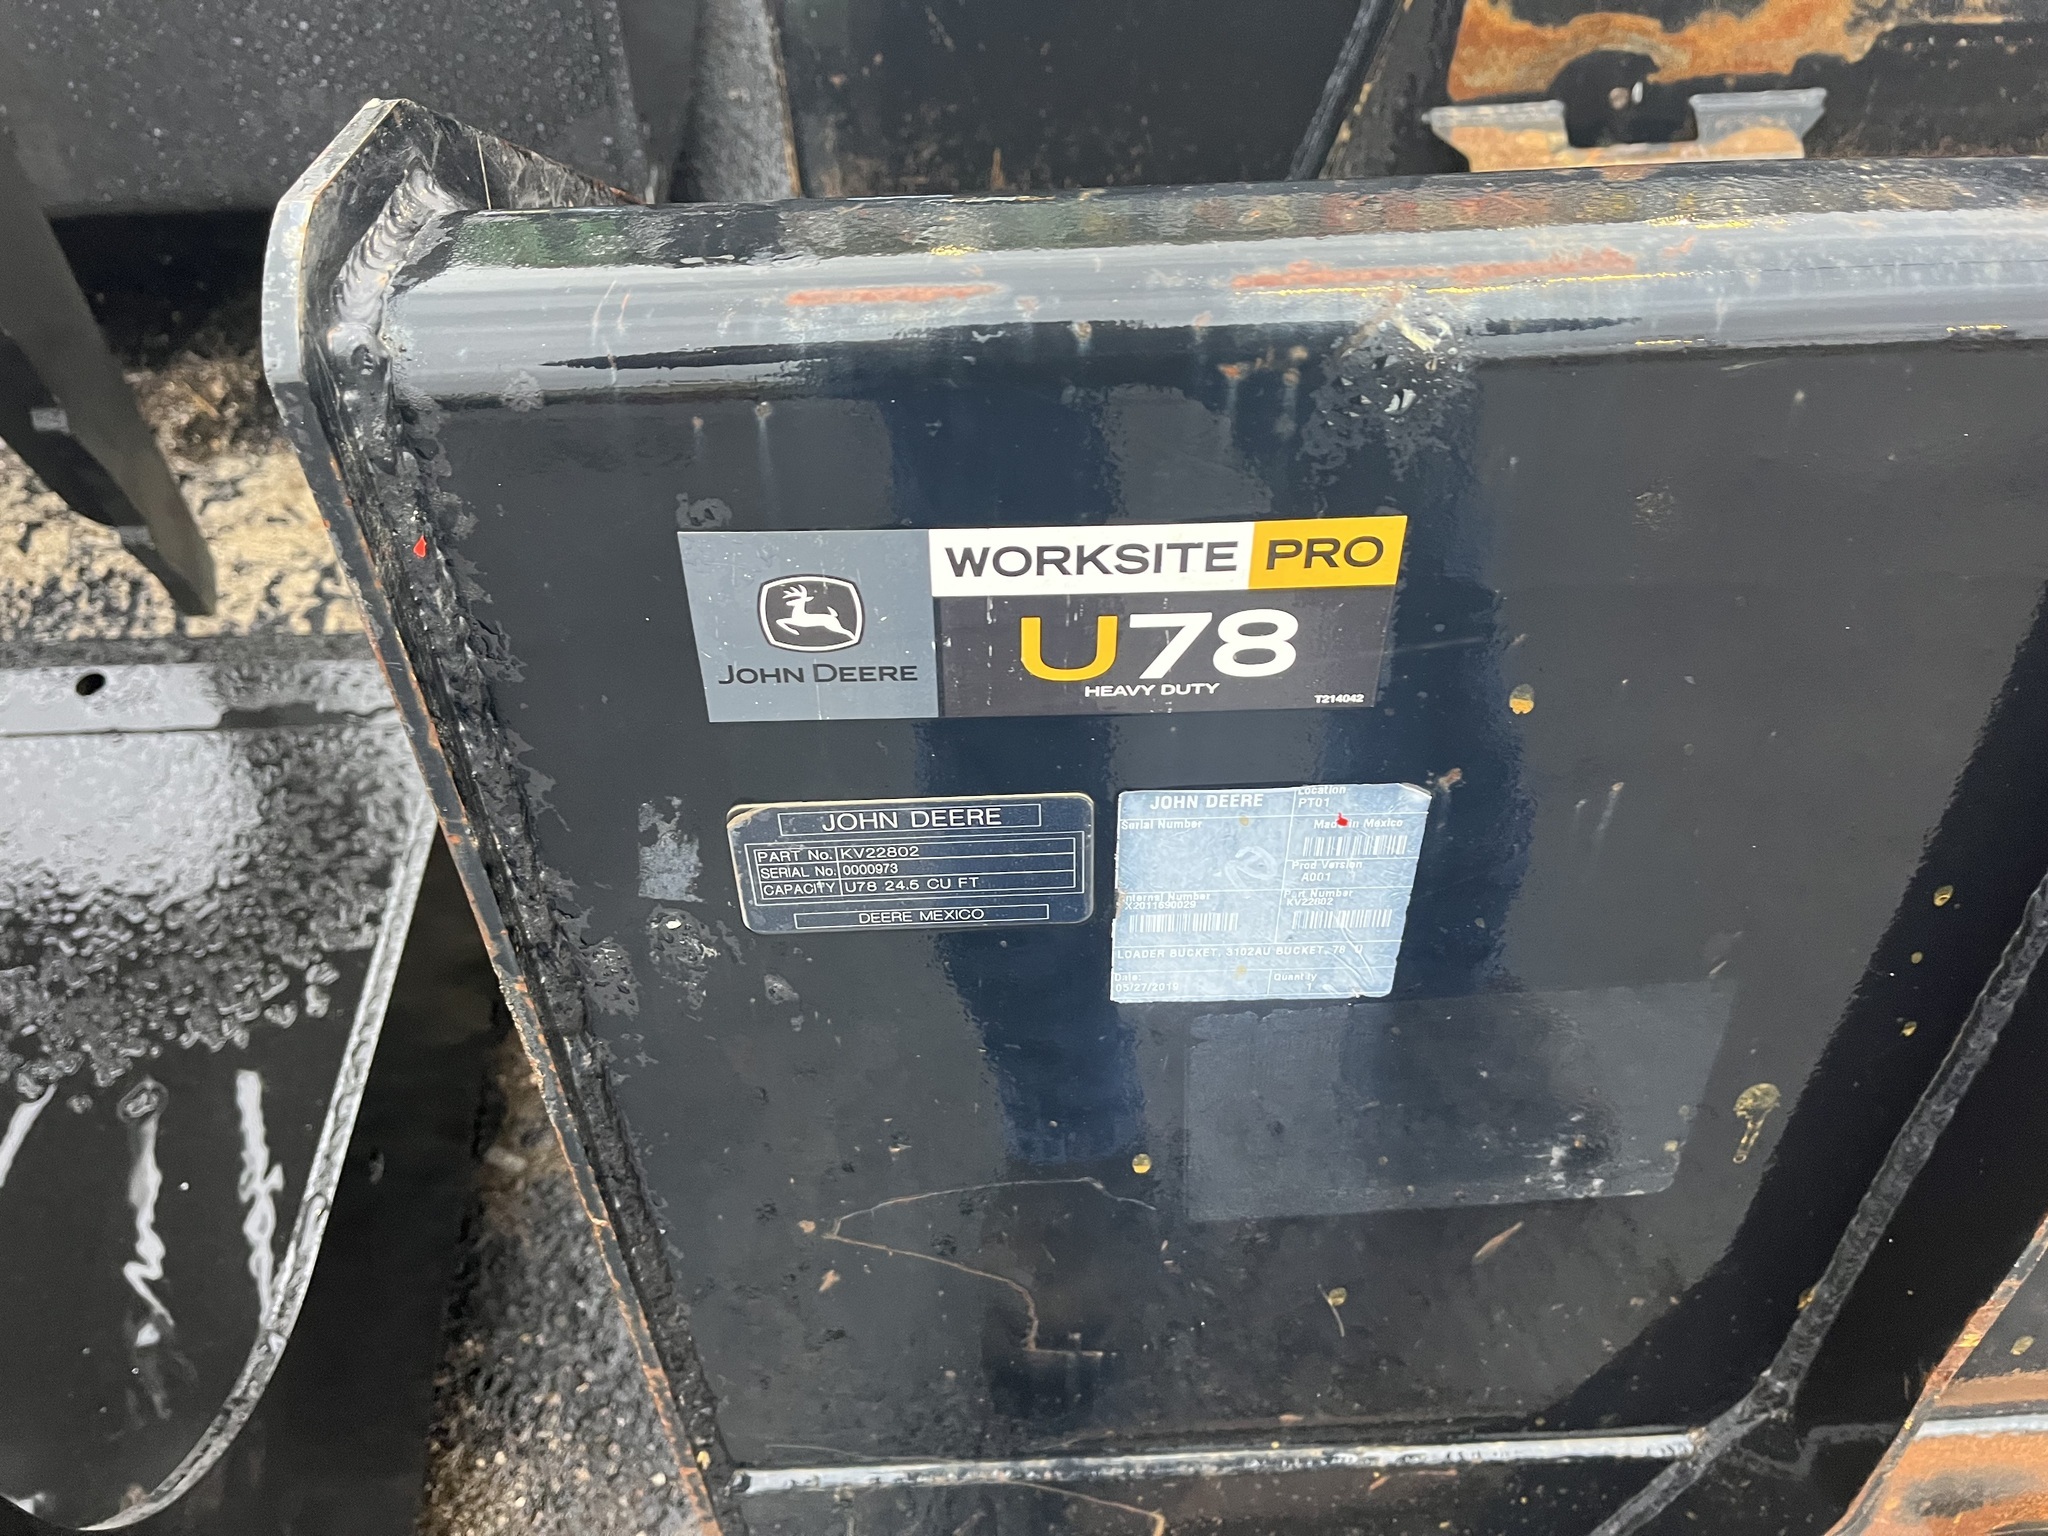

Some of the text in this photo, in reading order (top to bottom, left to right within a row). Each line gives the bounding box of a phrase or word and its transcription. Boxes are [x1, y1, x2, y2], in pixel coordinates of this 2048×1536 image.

[944, 535, 1385, 578] WORKSITE PRO
[1020, 608, 1298, 682] U78
[718, 662, 918, 686] JOHN DEERE
[1085, 683, 1220, 698] HEAVY DUTY
[1314, 693, 1365, 703] T214042
[1298, 784, 1347, 796] Location
[1150, 793, 1264, 810] JOHN DEERE
[1298, 797, 1330, 808] PT01
[822, 808, 1002, 831] JOHN DEERE
[1121, 819, 1203, 830] Serial Number
[1314, 818, 1349, 829] Mad
[1363, 818, 1403, 828] Mexico
[757, 849, 834, 863] PART No.
[841, 846, 920, 859] KV22802
[843, 863, 898, 875] 0000973
[1292, 860, 1363, 869] Prod Version
[760, 866, 810, 879] SERIAL
[1301, 872, 1331, 882] A001
[763, 881, 836, 896] CAPACITY
[845, 877, 980, 893] U78 24.5 CU FT
[1122, 892, 1211, 902] nternal Number
[1310, 889, 1353, 898] Number
[859, 909, 985, 924] DEERE MEXICO
[1117, 949, 1165, 959] LOADER
[1169, 948, 1221, 958] BUCKET,
[1226, 947, 1270, 957] 3102AU
[1333, 945, 1346, 954] 78
[1114, 973, 1142, 982] Date:
